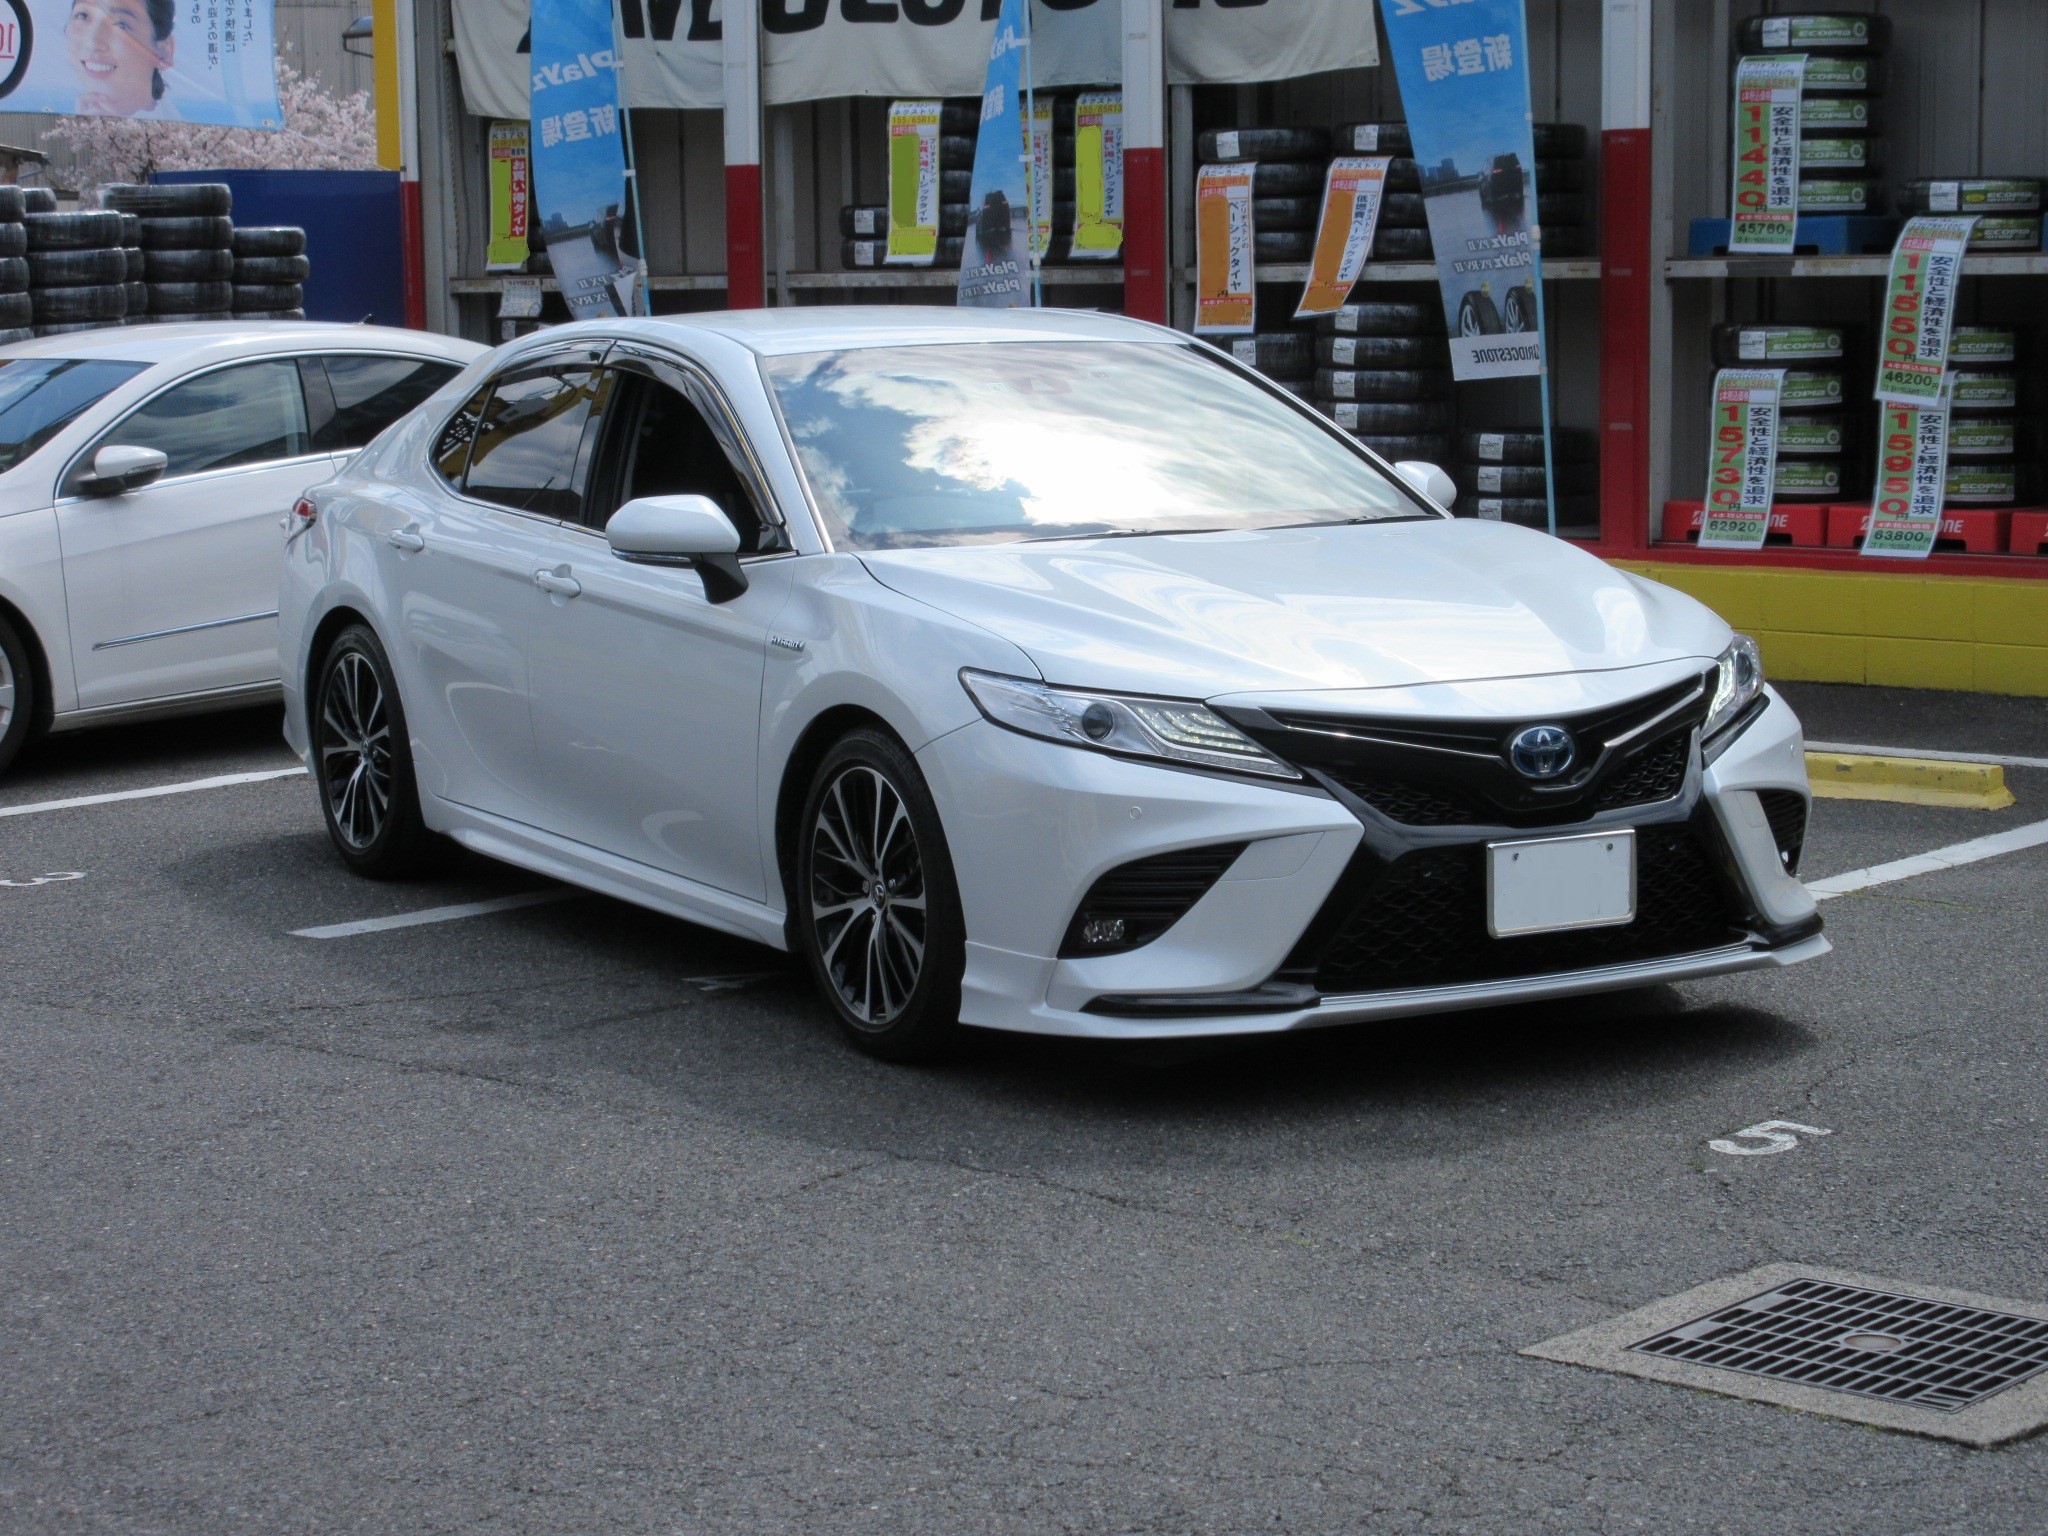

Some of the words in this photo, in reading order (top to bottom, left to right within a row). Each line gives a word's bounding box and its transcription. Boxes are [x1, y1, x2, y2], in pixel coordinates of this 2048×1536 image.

[1770, 106, 1794, 206] 安全性と経済性を追求
[1920, 256, 1953, 357] 安全性と経済性を追求
[1744, 407, 1771, 505] 安全性と経済性を追求
[1912, 414, 1942, 514] 安全性と経済性を追求
